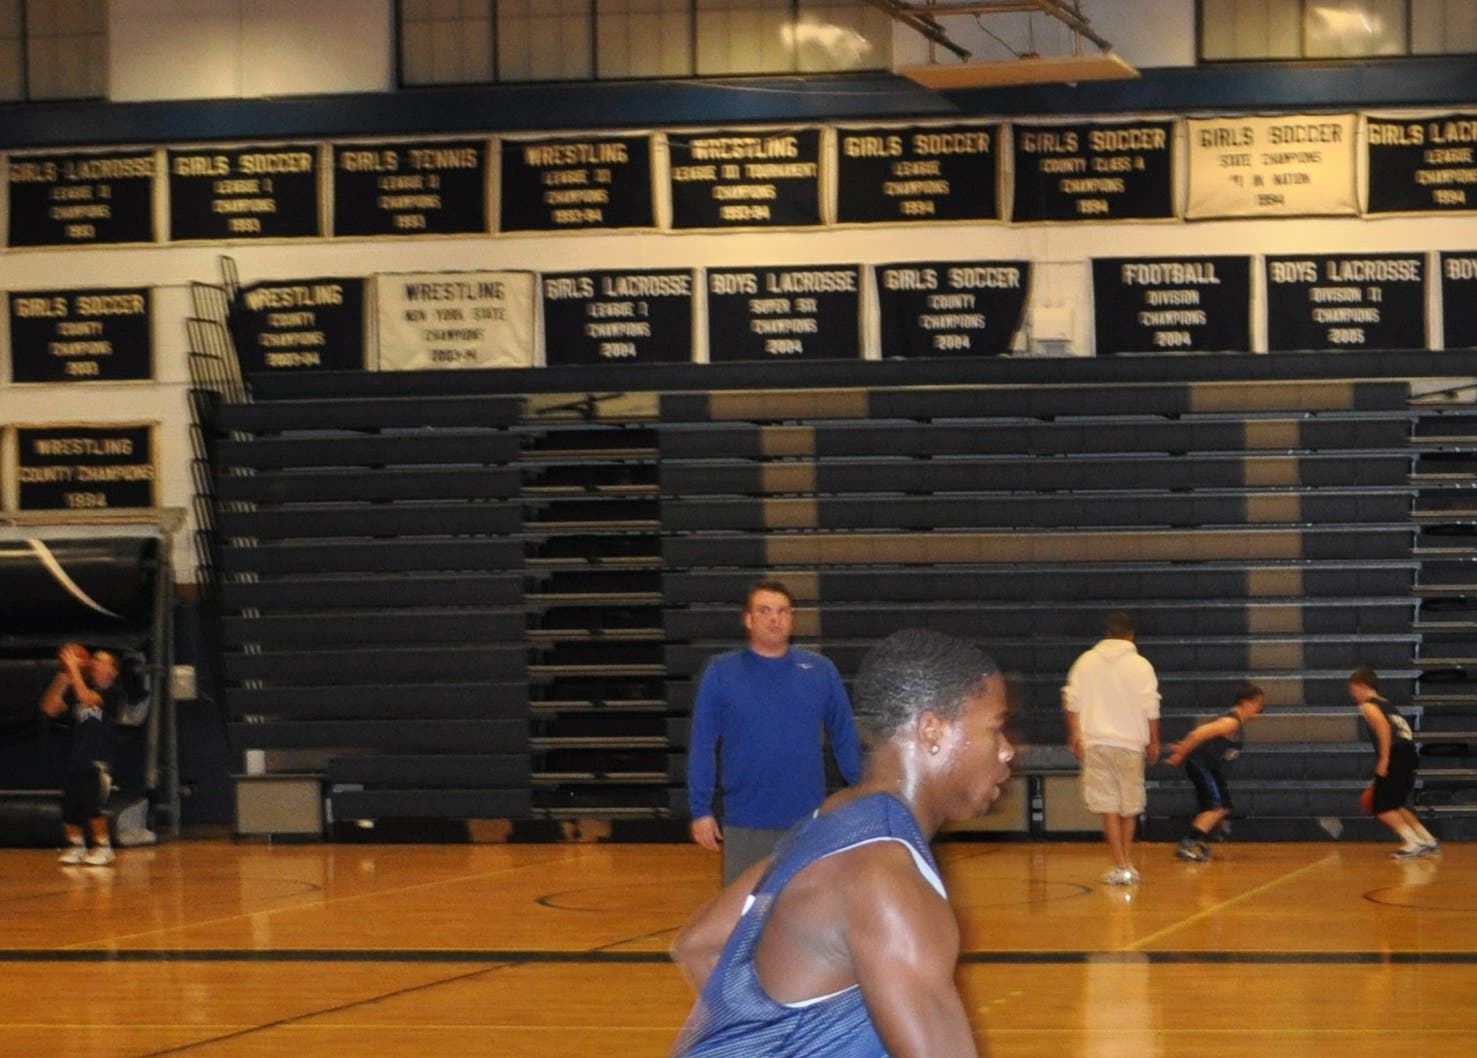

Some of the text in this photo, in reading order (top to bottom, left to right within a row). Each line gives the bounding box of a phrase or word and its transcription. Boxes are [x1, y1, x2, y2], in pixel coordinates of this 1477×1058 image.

[843, 133, 989, 157] GIRLS SOCCER
[1021, 128, 1166, 153] GIRLS SOCCER
[1200, 124, 1343, 148] GIRLS SOCCER
[1368, 124, 1424, 145] GIRLS
[524, 143, 629, 166] WRESTLING
[690, 137, 798, 159] WRESTLING
[174, 153, 311, 175] GIRLS SOCCER
[340, 149, 477, 171] GIRLS TENNIS
[1040, 158, 1087, 173] COUNTY
[1060, 178, 1125, 193] CHAMPIONS
[884, 268, 1020, 290] GIRLS SOCCER
[1121, 263, 1221, 286] FOOTBALL
[1271, 259, 1421, 283] BOYS LACROSSE
[405, 282, 505, 301] WRESTLING
[546, 275, 691, 299] GIRLS LACROSSE
[709, 271, 857, 295] BOYS LACROSSE
[15, 295, 144, 317] GIRLS SOCCER
[244, 285, 343, 309] WRESTLING
[927, 294, 976, 309] COUNTY
[1145, 290, 1199, 305] DIVISION
[1309, 287, 1362, 303] DIVISION
[751, 319, 818, 335] CHAMPIONS
[919, 314, 986, 330] CHAMPIONS
[1138, 310, 1206, 326] CHAMPIONS
[1312, 308, 1380, 324] CHAMPIONS
[584, 323, 650, 337] CHAMPIONS
[36, 439, 133, 455] WRESTLING
